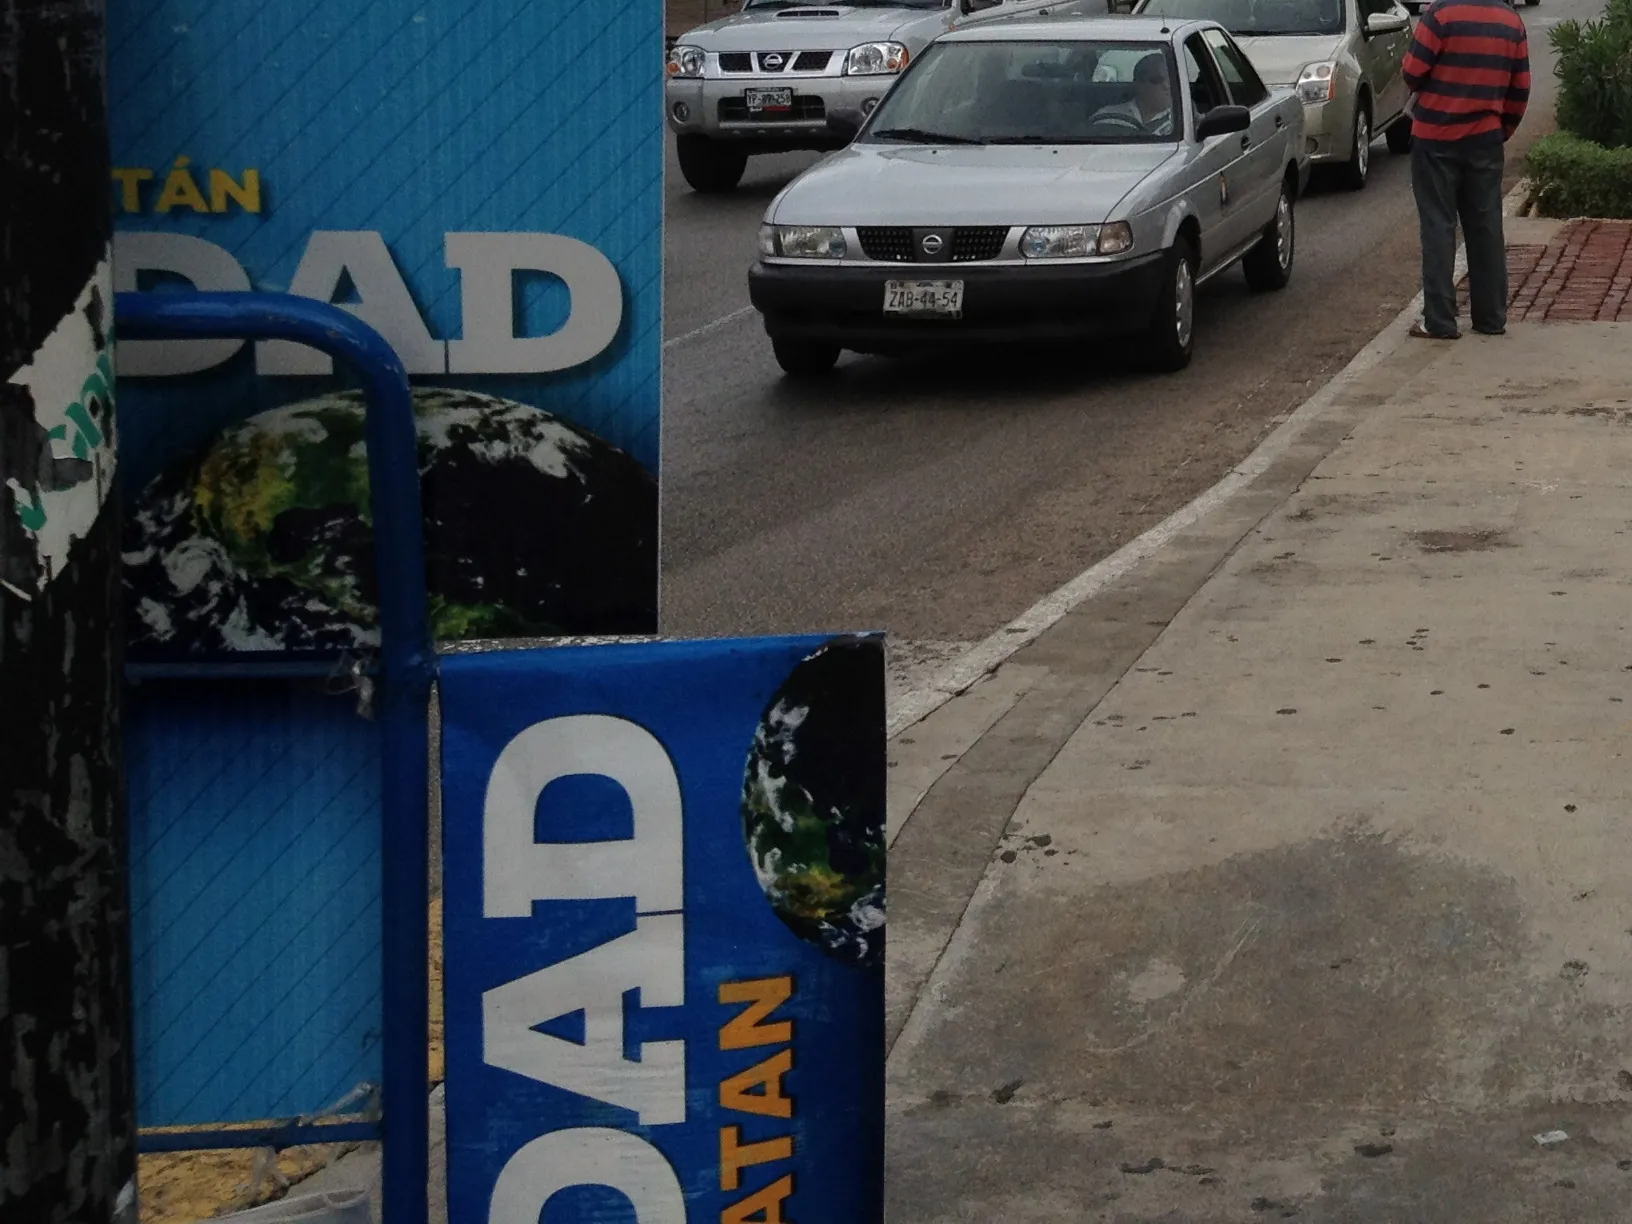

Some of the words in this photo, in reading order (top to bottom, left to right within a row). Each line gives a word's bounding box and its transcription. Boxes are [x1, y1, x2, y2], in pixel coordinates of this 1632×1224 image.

[112, 155, 261, 214] TÁN
[113, 230, 623, 377] DAD
[889, 290, 959, 308] ZAB-44-54
